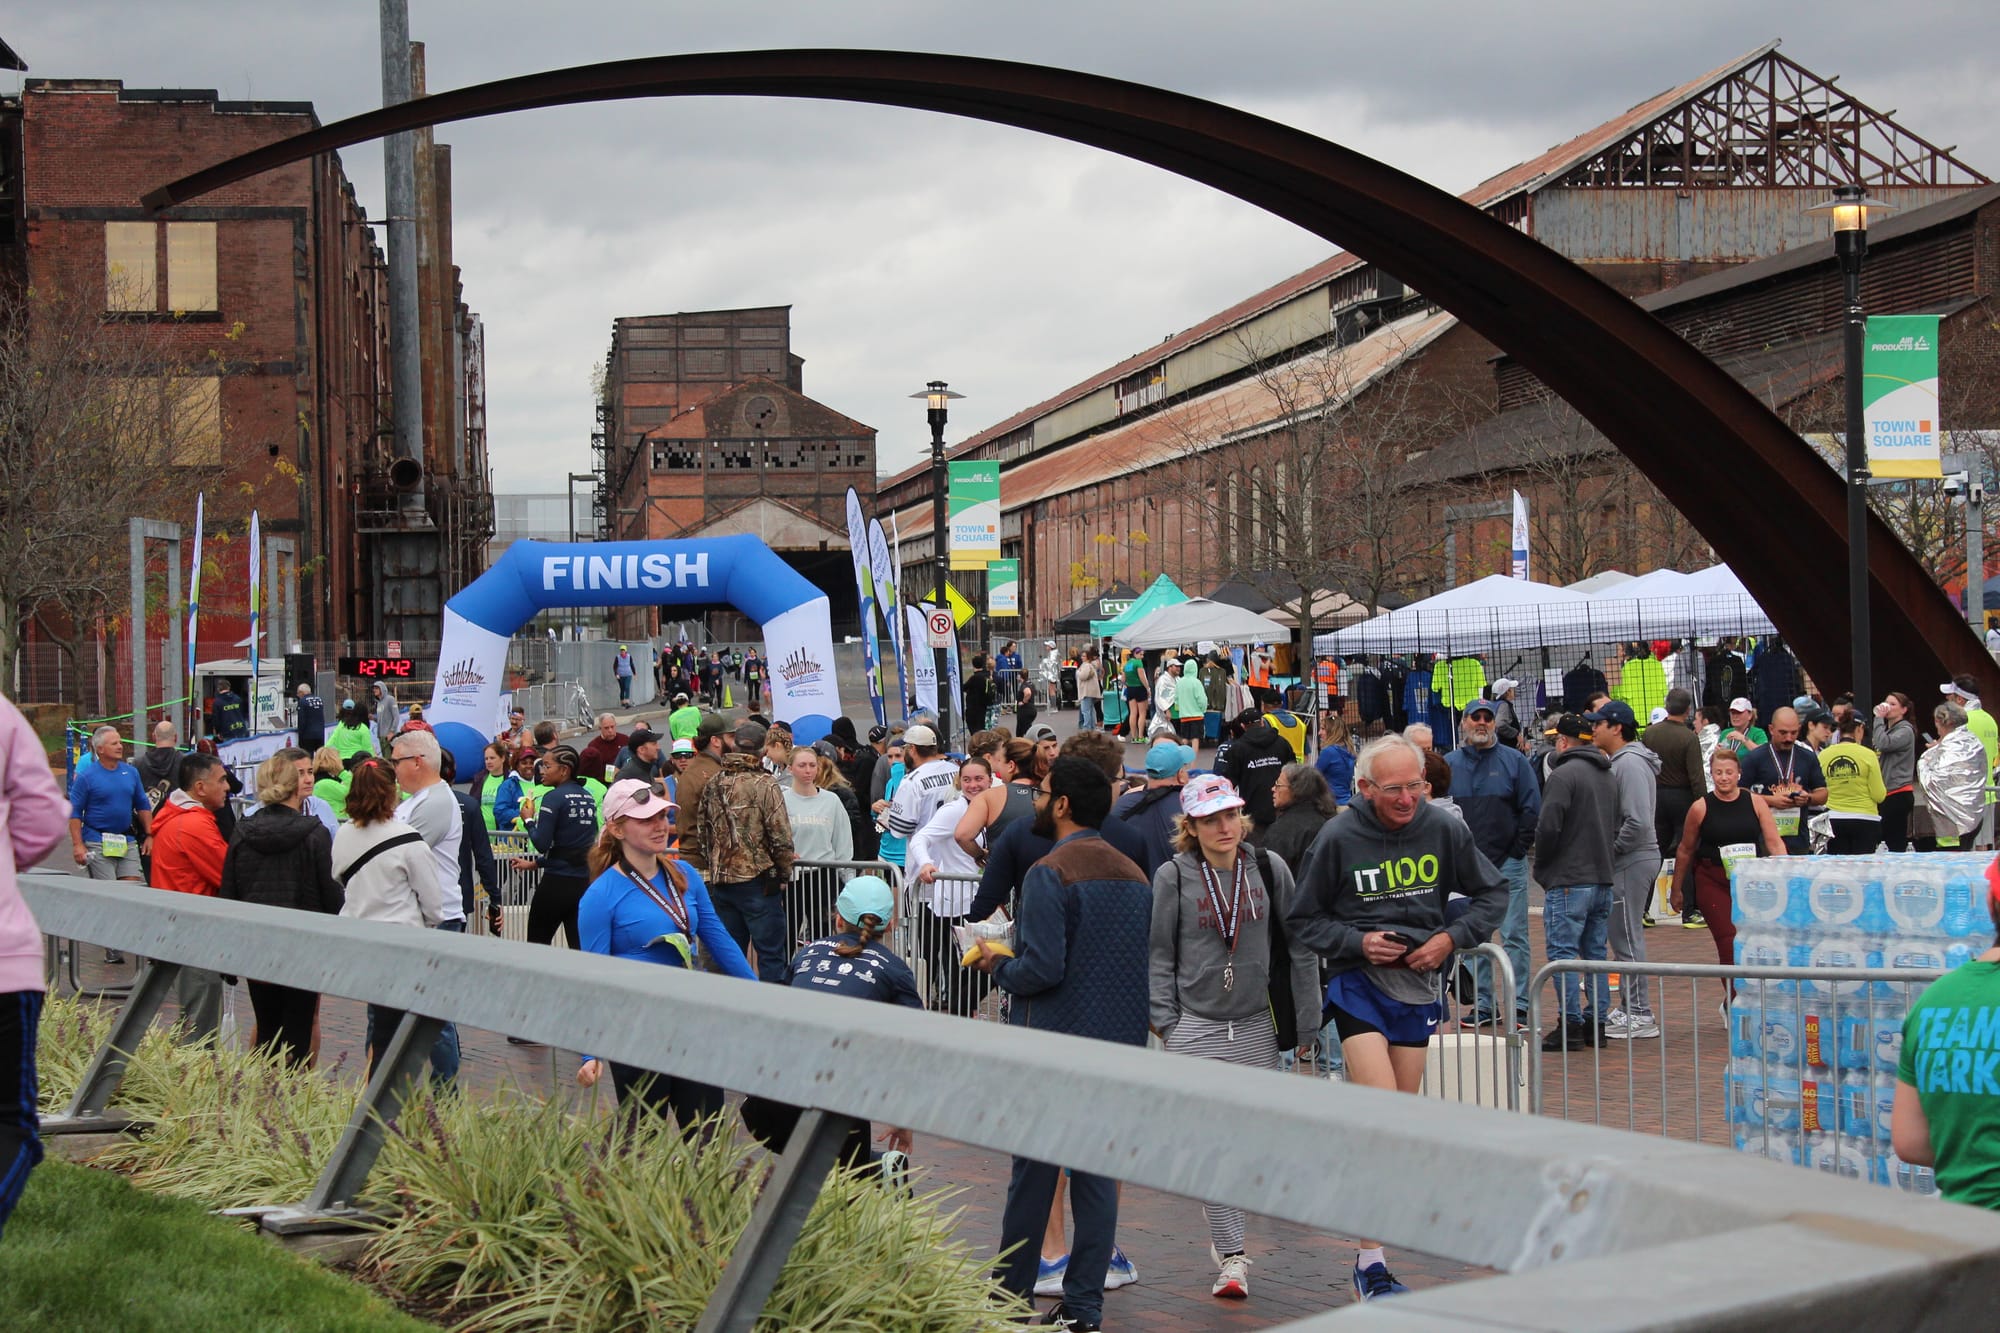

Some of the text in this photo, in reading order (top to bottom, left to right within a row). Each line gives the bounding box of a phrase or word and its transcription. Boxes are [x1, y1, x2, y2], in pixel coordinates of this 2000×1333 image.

[1872, 343, 1913, 351] PRODUCTS
[1872, 420, 1915, 433] TOWN
[1873, 434, 1931, 448] SQUARE
[955, 525, 985, 533] TOWN
[955, 534, 995, 542] SQUARE
[543, 553, 709, 591] FINISH
[261, 702, 275, 713] Wind
[1806, 1023, 1818, 1033] 40
[1918, 1006, 2000, 1050] TEAM
[1803, 1088, 1816, 1098] 40
